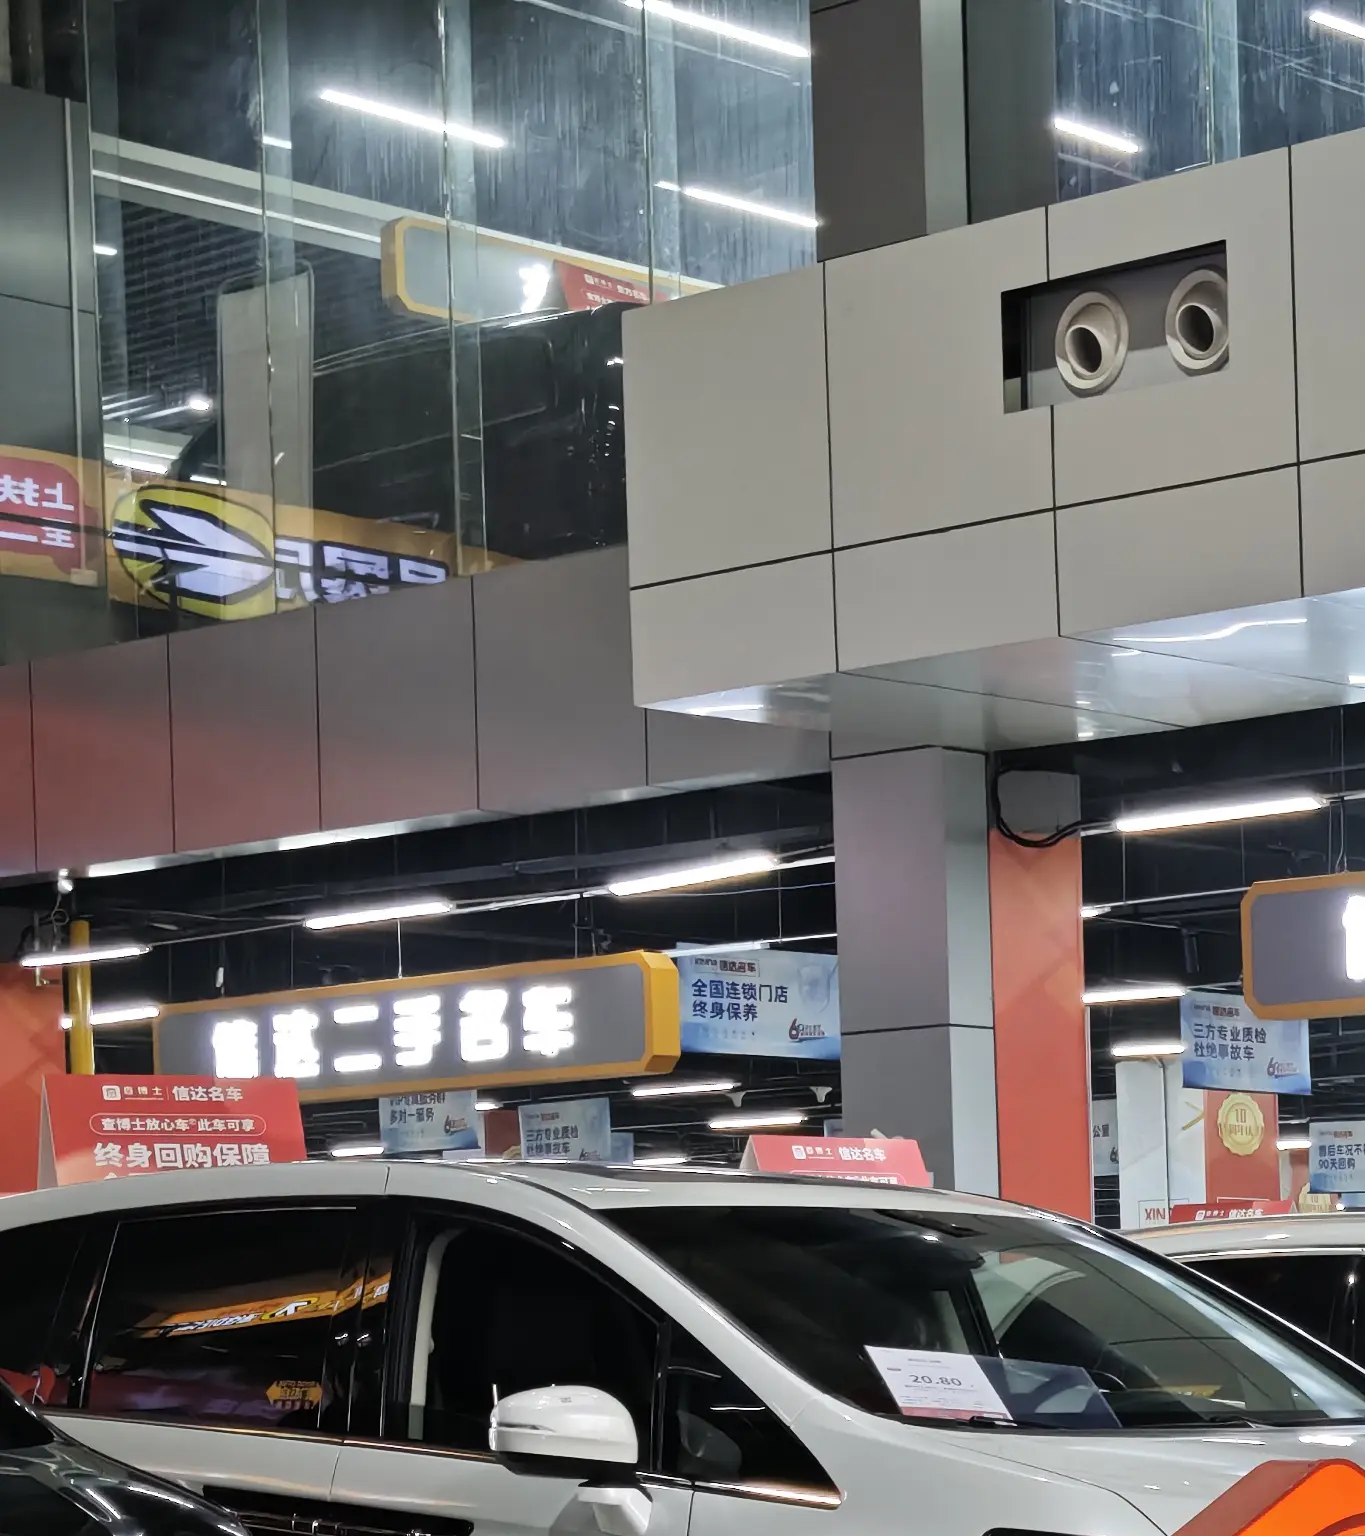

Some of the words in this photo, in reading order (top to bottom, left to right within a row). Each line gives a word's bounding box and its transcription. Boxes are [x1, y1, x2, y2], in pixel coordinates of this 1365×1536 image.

[691, 978, 789, 1003] 全国连锁门店
[692, 1000, 758, 1022] 终身保养
[1193, 1023, 1267, 1044] 三方专业质检
[1194, 1043, 1256, 1061] 杜绝事故车
[172, 1085, 243, 1103] 信达名车
[93, 1142, 271, 1169] 终身回购保障
[1318, 1157, 1356, 1170] 90天回购
